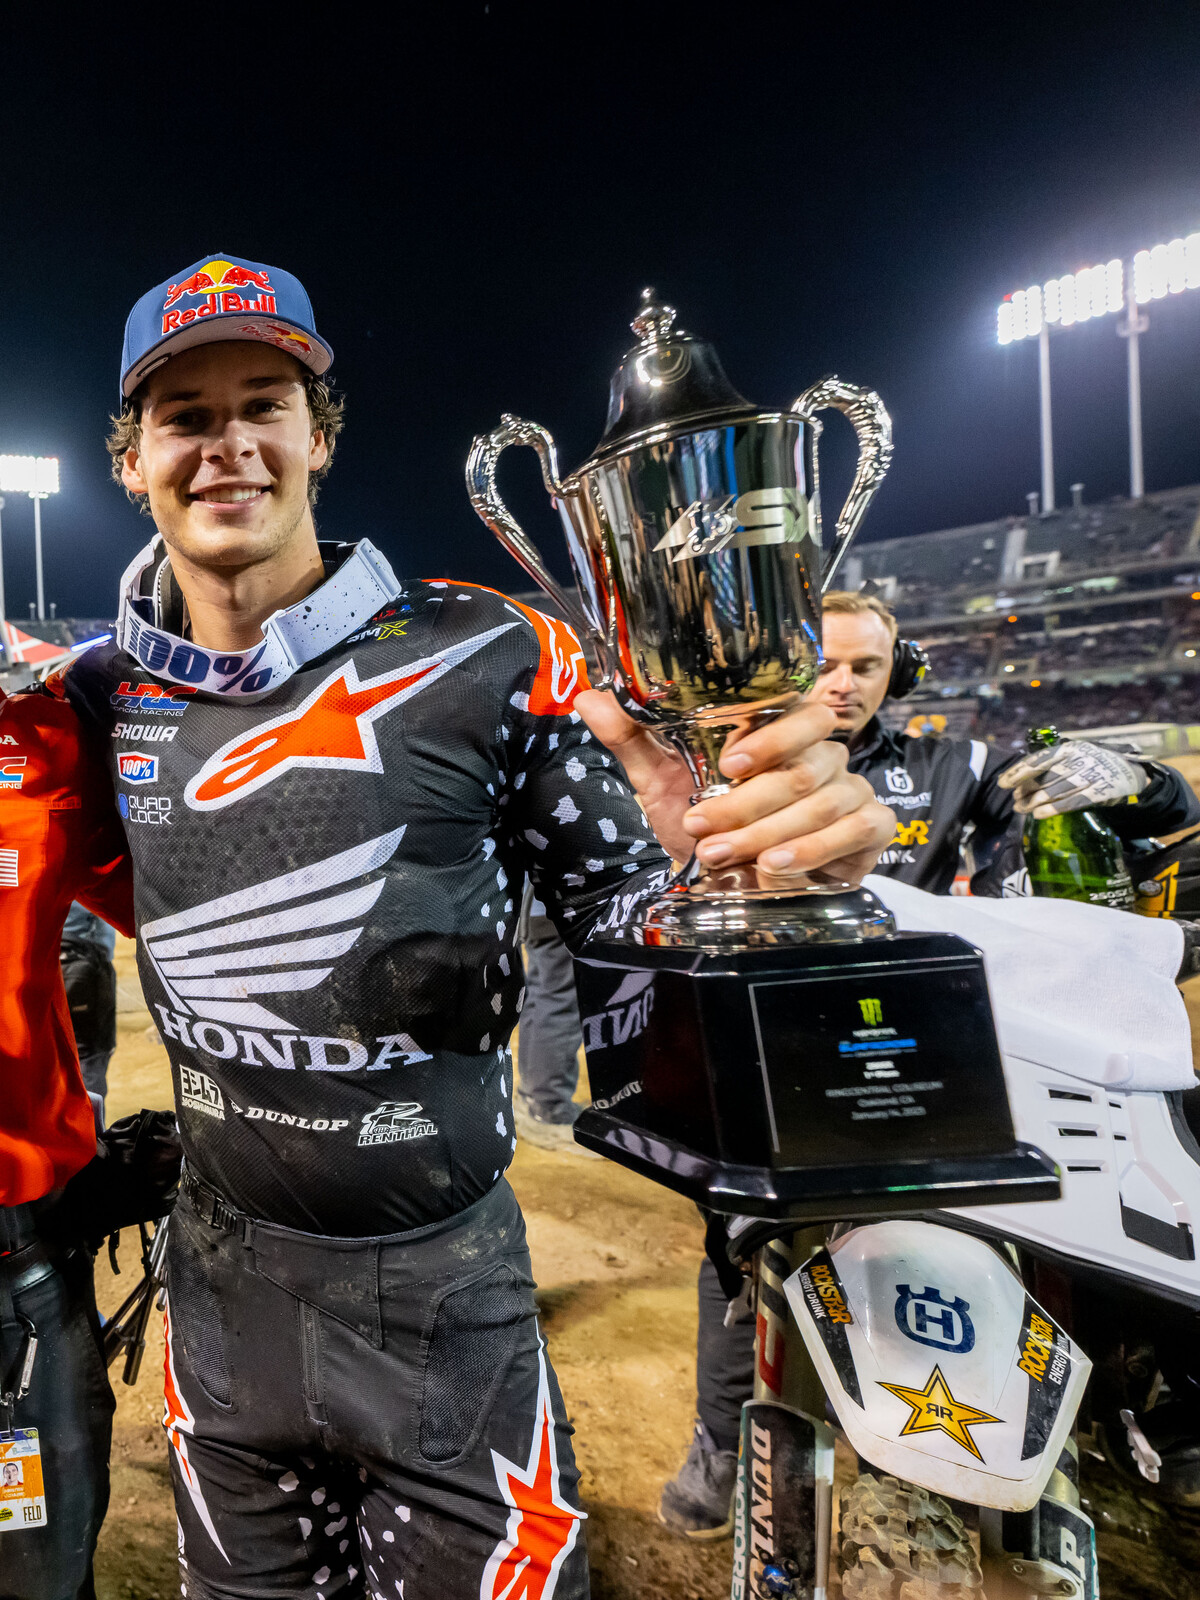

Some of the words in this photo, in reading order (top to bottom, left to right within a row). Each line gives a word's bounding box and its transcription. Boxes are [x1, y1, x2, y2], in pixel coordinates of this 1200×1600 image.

[161, 293, 219, 336] Red
[220, 292, 277, 314] Bull
[110, 682, 199, 711] HRC
[112, 706, 138, 714] onda
[139, 709, 184, 717] RACING
[111, 723, 179, 742] SHOWA
[121, 758, 152, 777] 100%
[129, 796, 172, 810] QUAD
[130, 809, 172, 825] LOCK
[154, 1003, 433, 1072] HONDA
[245, 1107, 349, 1132] DUNLOP
[358, 1122, 438, 1146] RENTHAL
[809, 1264, 853, 1325] ROCKSTAR
[809, 1291, 827, 1319] DRINK
[1016, 1313, 1053, 1382] ROCKSTAR
[23, 1505, 42, 1522] FELD
[750, 1418, 775, 1600] DUNL
[731, 1465, 748, 1600] MOTORE
